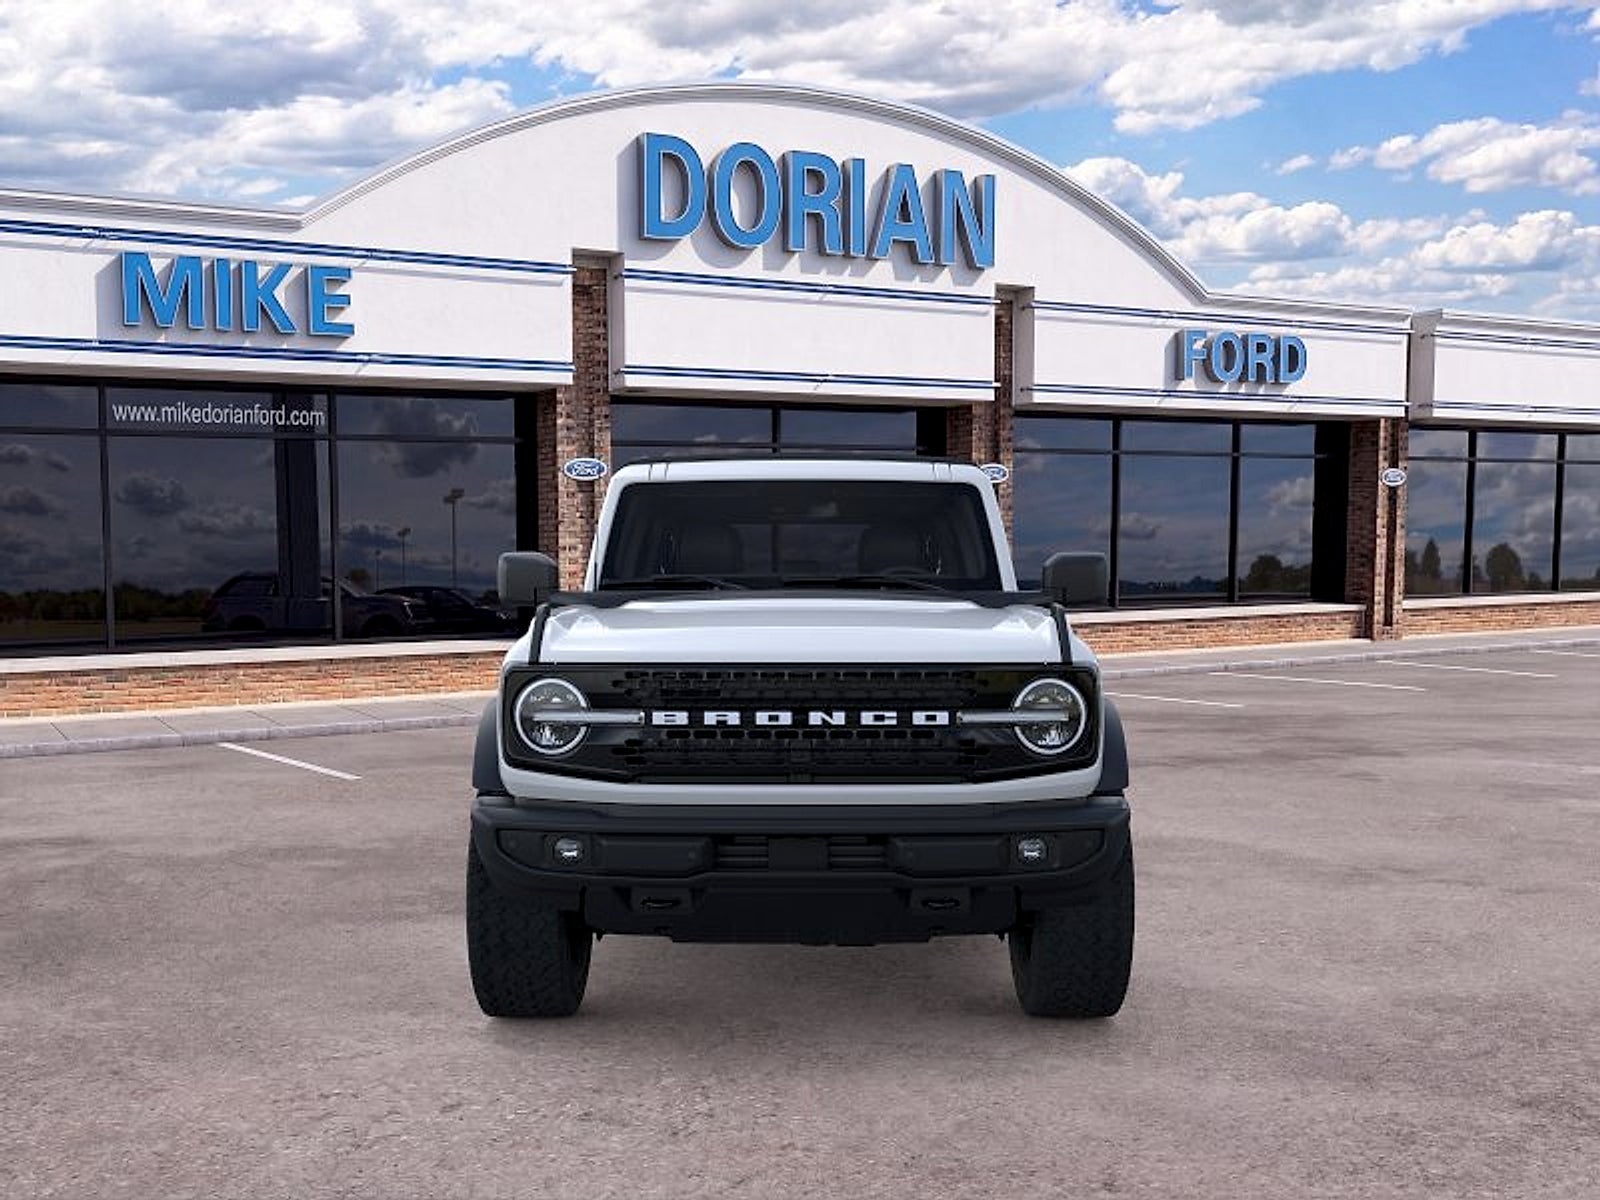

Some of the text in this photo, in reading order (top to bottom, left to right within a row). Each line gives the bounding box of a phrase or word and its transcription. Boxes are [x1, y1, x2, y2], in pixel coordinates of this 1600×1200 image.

[640, 131, 996, 270] DORIAN
[120, 251, 355, 337] MIKE
[1181, 328, 1308, 383] FORD
[112, 402, 326, 427] www.mikedorianford.com
[651, 711, 949, 725] BRONCO
